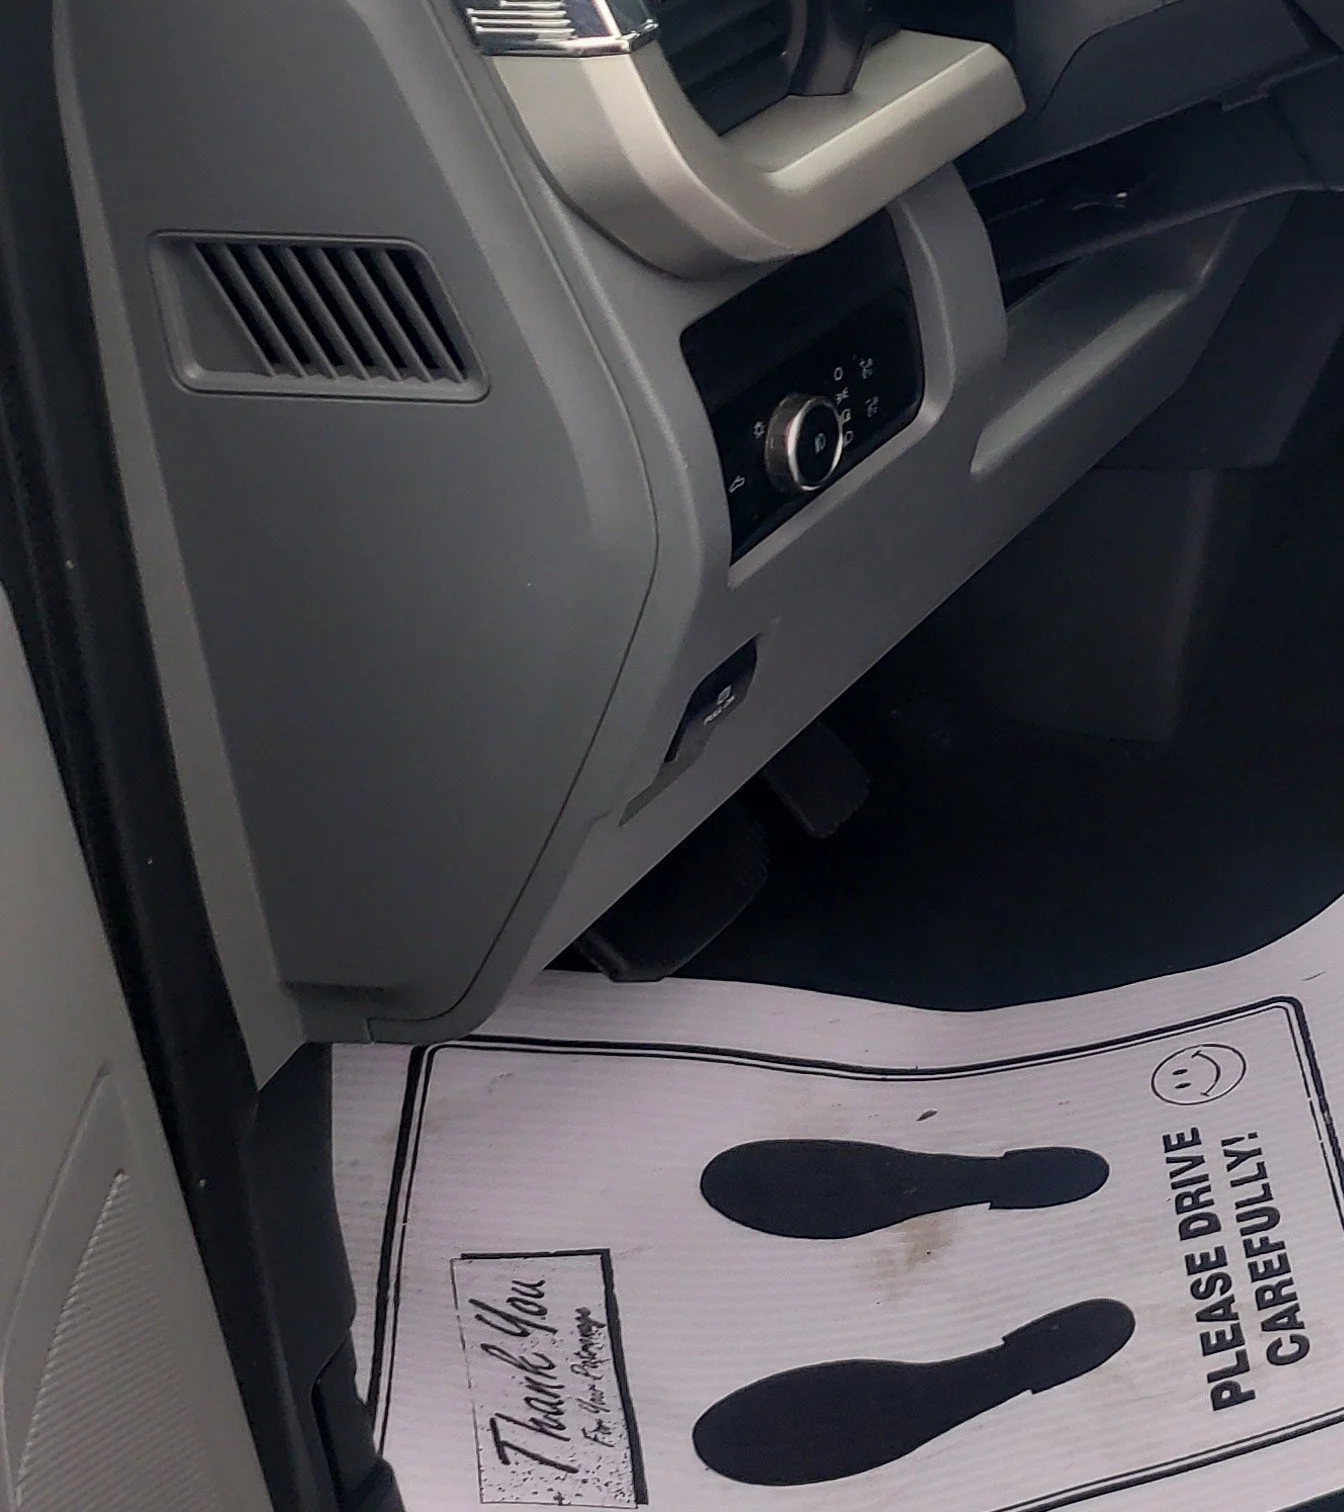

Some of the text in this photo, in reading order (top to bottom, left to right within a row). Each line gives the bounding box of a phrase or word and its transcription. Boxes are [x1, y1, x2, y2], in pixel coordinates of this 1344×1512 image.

[1162, 1126, 1256, 1411] PLEASE DRIVE
[1220, 1131, 1310, 1366] CAREFULLY!
[468, 1280, 579, 1474] Thank You
